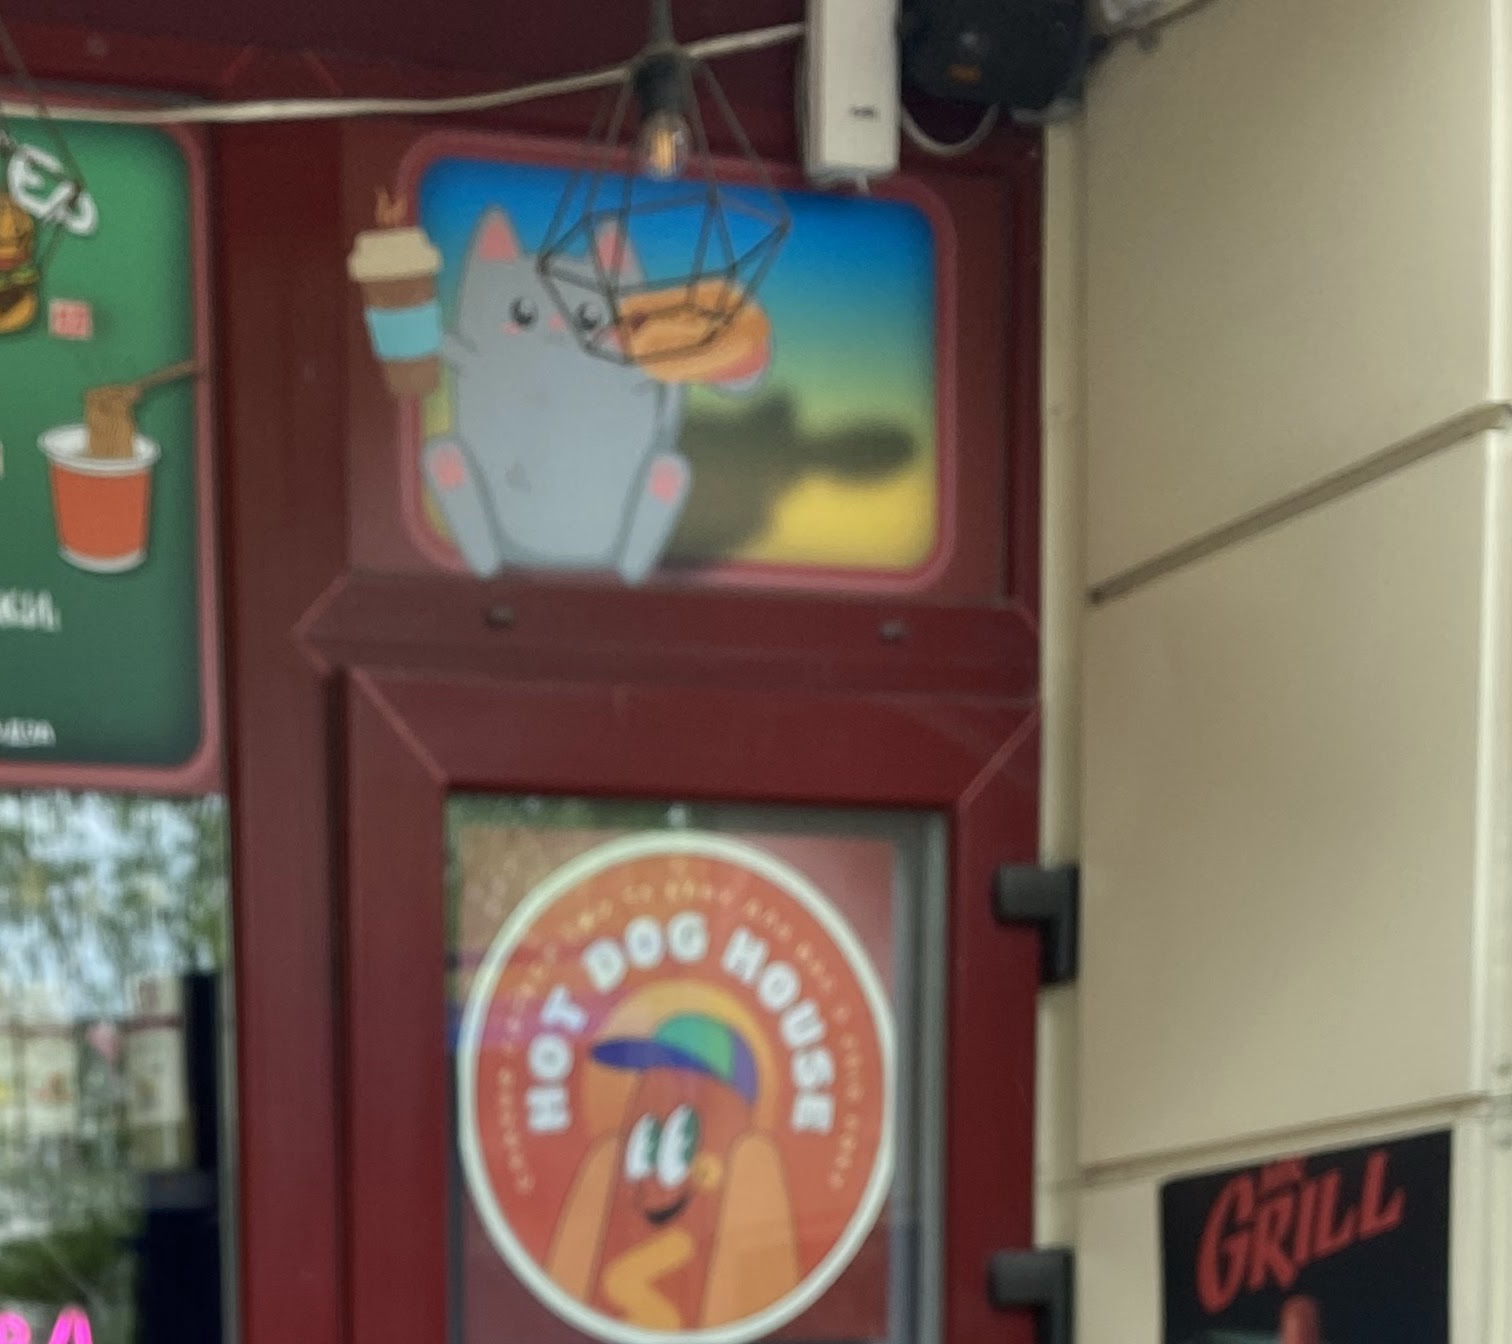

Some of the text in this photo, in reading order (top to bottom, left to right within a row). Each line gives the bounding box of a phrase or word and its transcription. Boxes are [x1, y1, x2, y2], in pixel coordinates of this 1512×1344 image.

[525, 984, 586, 1136] HOT
[580, 909, 711, 994] DOG
[719, 925, 837, 1136] HOUSE
[1196, 1150, 1404, 1313] GRILL
